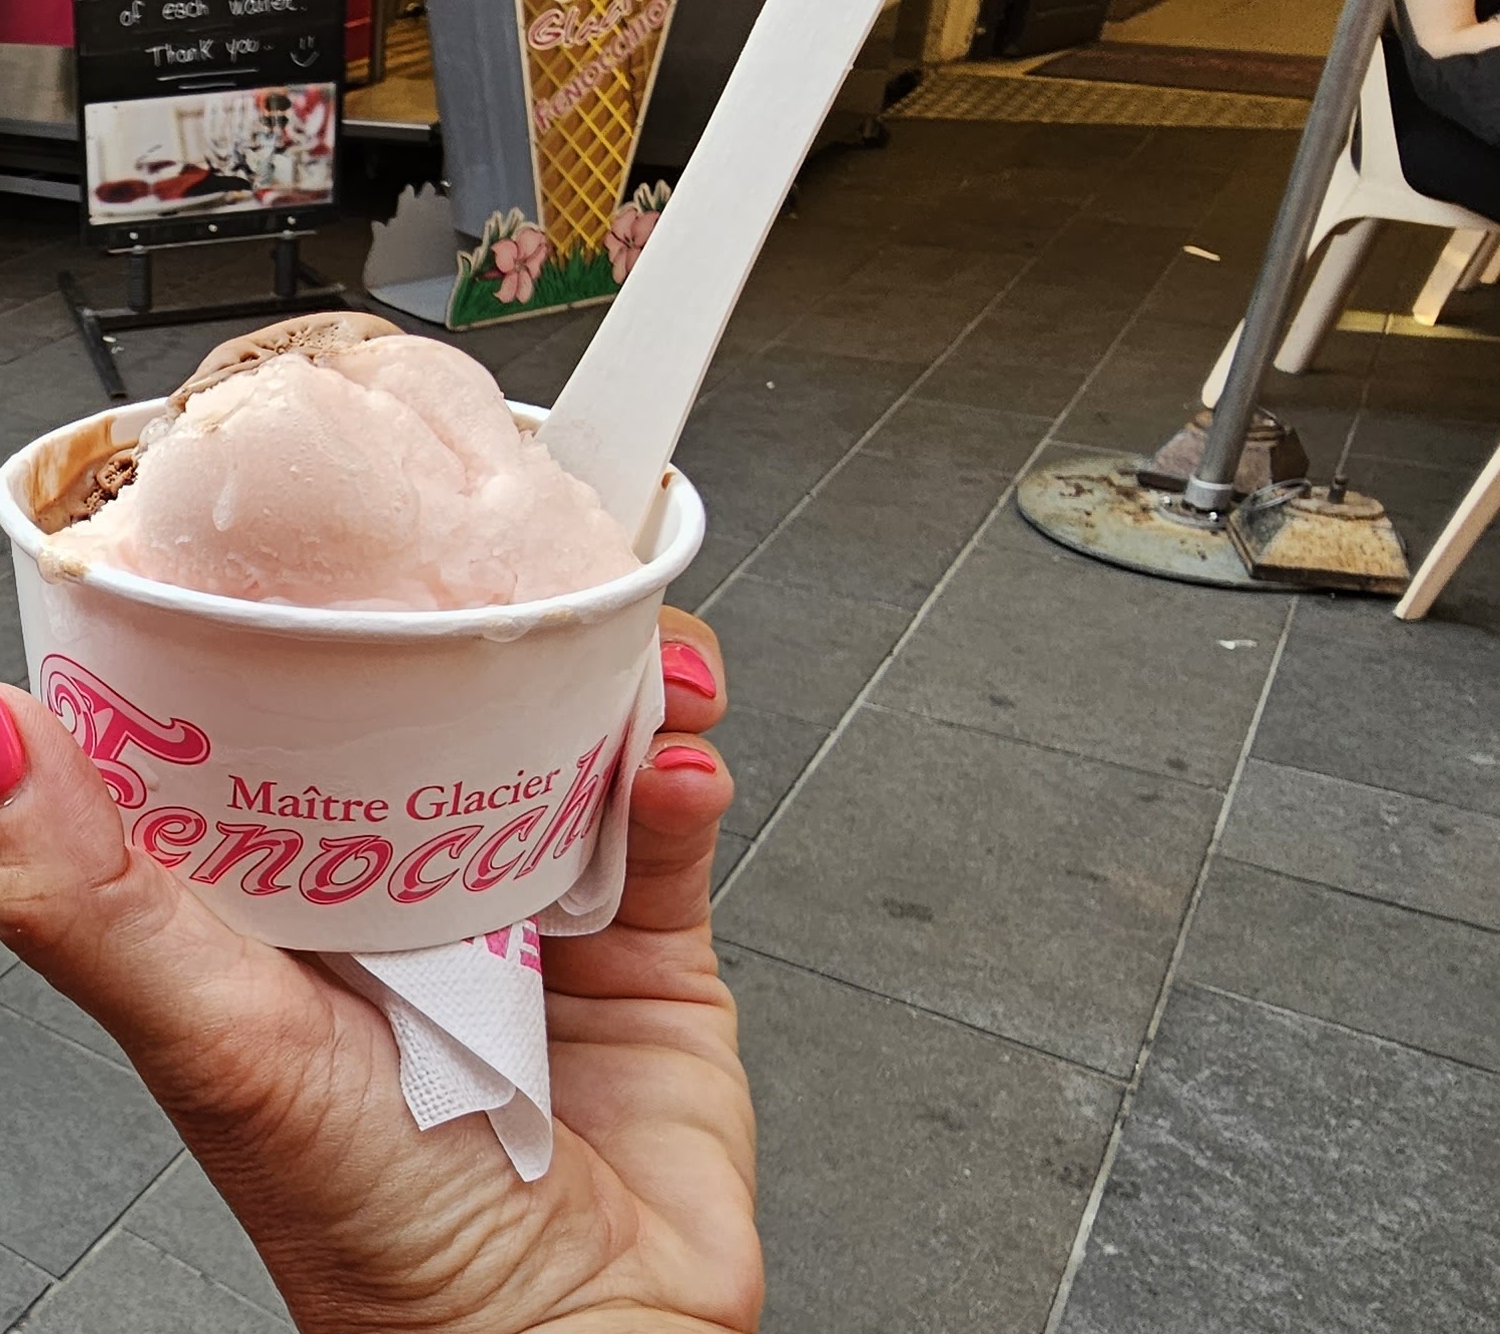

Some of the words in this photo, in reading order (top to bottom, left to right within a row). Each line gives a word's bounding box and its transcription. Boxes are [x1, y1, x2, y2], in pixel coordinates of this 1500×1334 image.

[119, 0, 143, 28] of
[144, 38, 214, 67] Thank
[226, 774, 390, 824] Maître
[406, 767, 562, 821] Glacier
